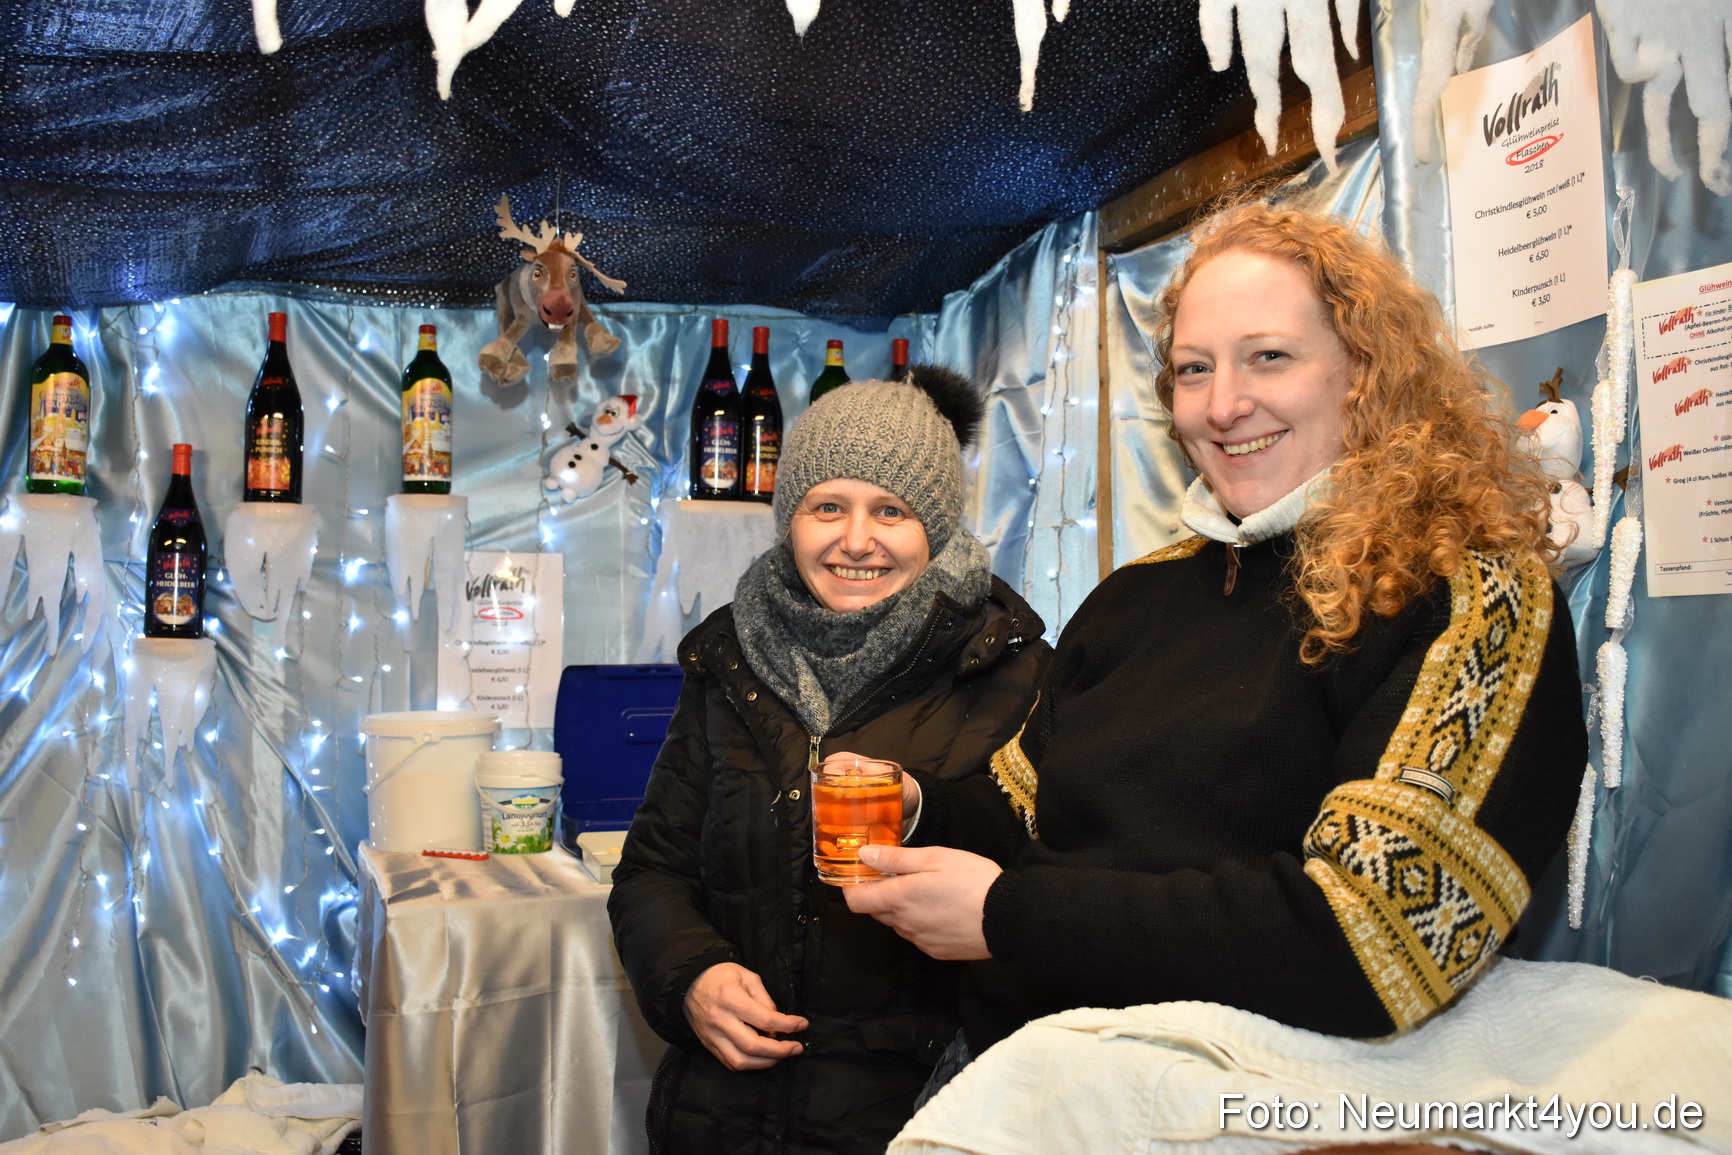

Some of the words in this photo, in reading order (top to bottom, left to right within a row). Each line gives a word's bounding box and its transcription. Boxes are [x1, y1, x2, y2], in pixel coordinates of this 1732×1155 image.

[1483, 62, 1559, 147] Vollrath
[1501, 118, 1560, 148] Glühweinpreise
[1516, 141, 1551, 160] Flaschen
[1524, 159, 1545, 174] 2018
[1474, 191, 1546, 220] Christkindlesglühwein
[1526, 210, 1532, 219] €
[1533, 204, 1548, 218] 5,00
[1498, 231, 1558, 258] Heidelbeerglühwein
[1529, 254, 1535, 263] €
[1536, 248, 1550, 262] 6,50
[1512, 278, 1553, 298] Kinderpunsch
[1531, 298, 1537, 307] €
[1538, 293, 1551, 305] 3,50
[1658, 306, 1694, 335] Vollrath
[1689, 330, 1706, 339] OHNE
[1706, 326, 1726, 336] Alkohol
[1652, 356, 1687, 384] Vollrath
[1674, 388, 1708, 416] Vollrath
[1648, 444, 1682, 471] Vollrath
[1683, 448, 1702, 456] Weißer
[1698, 510, 1720, 518] (Früchte,
[1660, 564, 1693, 572] Tassenpfand:
